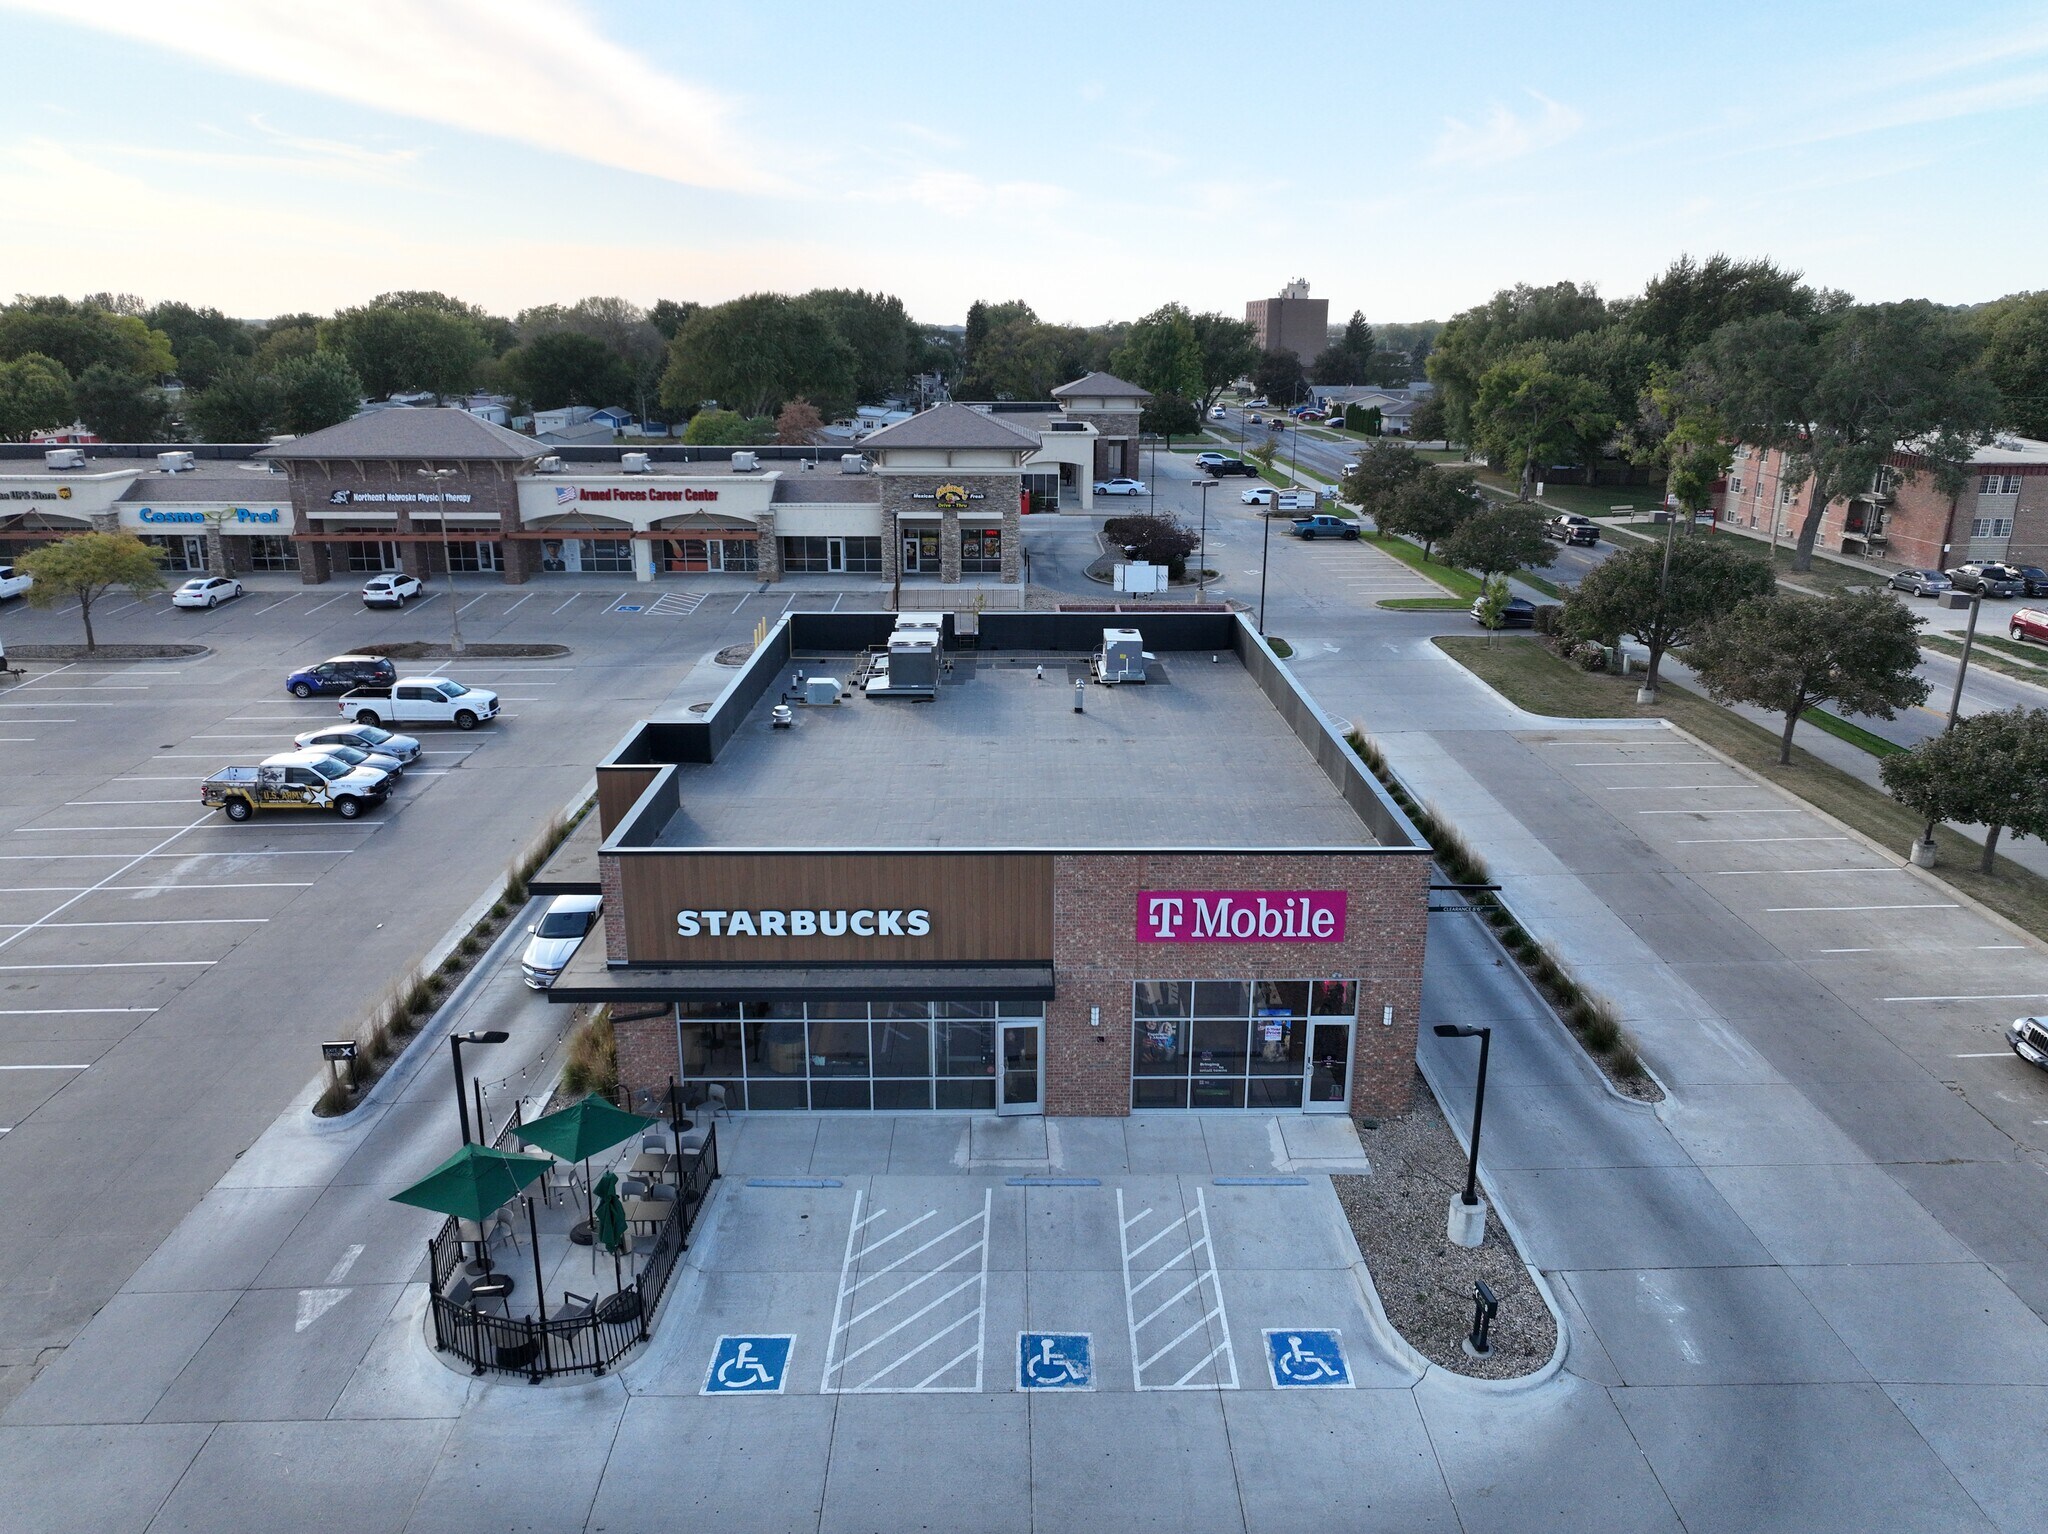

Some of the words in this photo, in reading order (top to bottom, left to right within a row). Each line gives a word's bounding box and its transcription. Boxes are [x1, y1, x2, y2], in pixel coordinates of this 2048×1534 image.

[10, 490, 31, 500] UPS
[353, 493, 386, 502] Northeast
[386, 493, 416, 502] Nebraska
[445, 493, 471, 504] Therapy
[580, 488, 611, 501] Armed
[613, 488, 647, 501] Forces
[649, 488, 683, 501] Career
[685, 488, 719, 501] Center
[139, 507, 206, 523] Cosmo
[236, 508, 280, 524] Prof
[263, 791, 280, 799] U.S.
[281, 791, 304, 800] ARMY
[675, 908, 932, 938] STARBUCKS
[1191, 896, 1336, 939] Mobile
